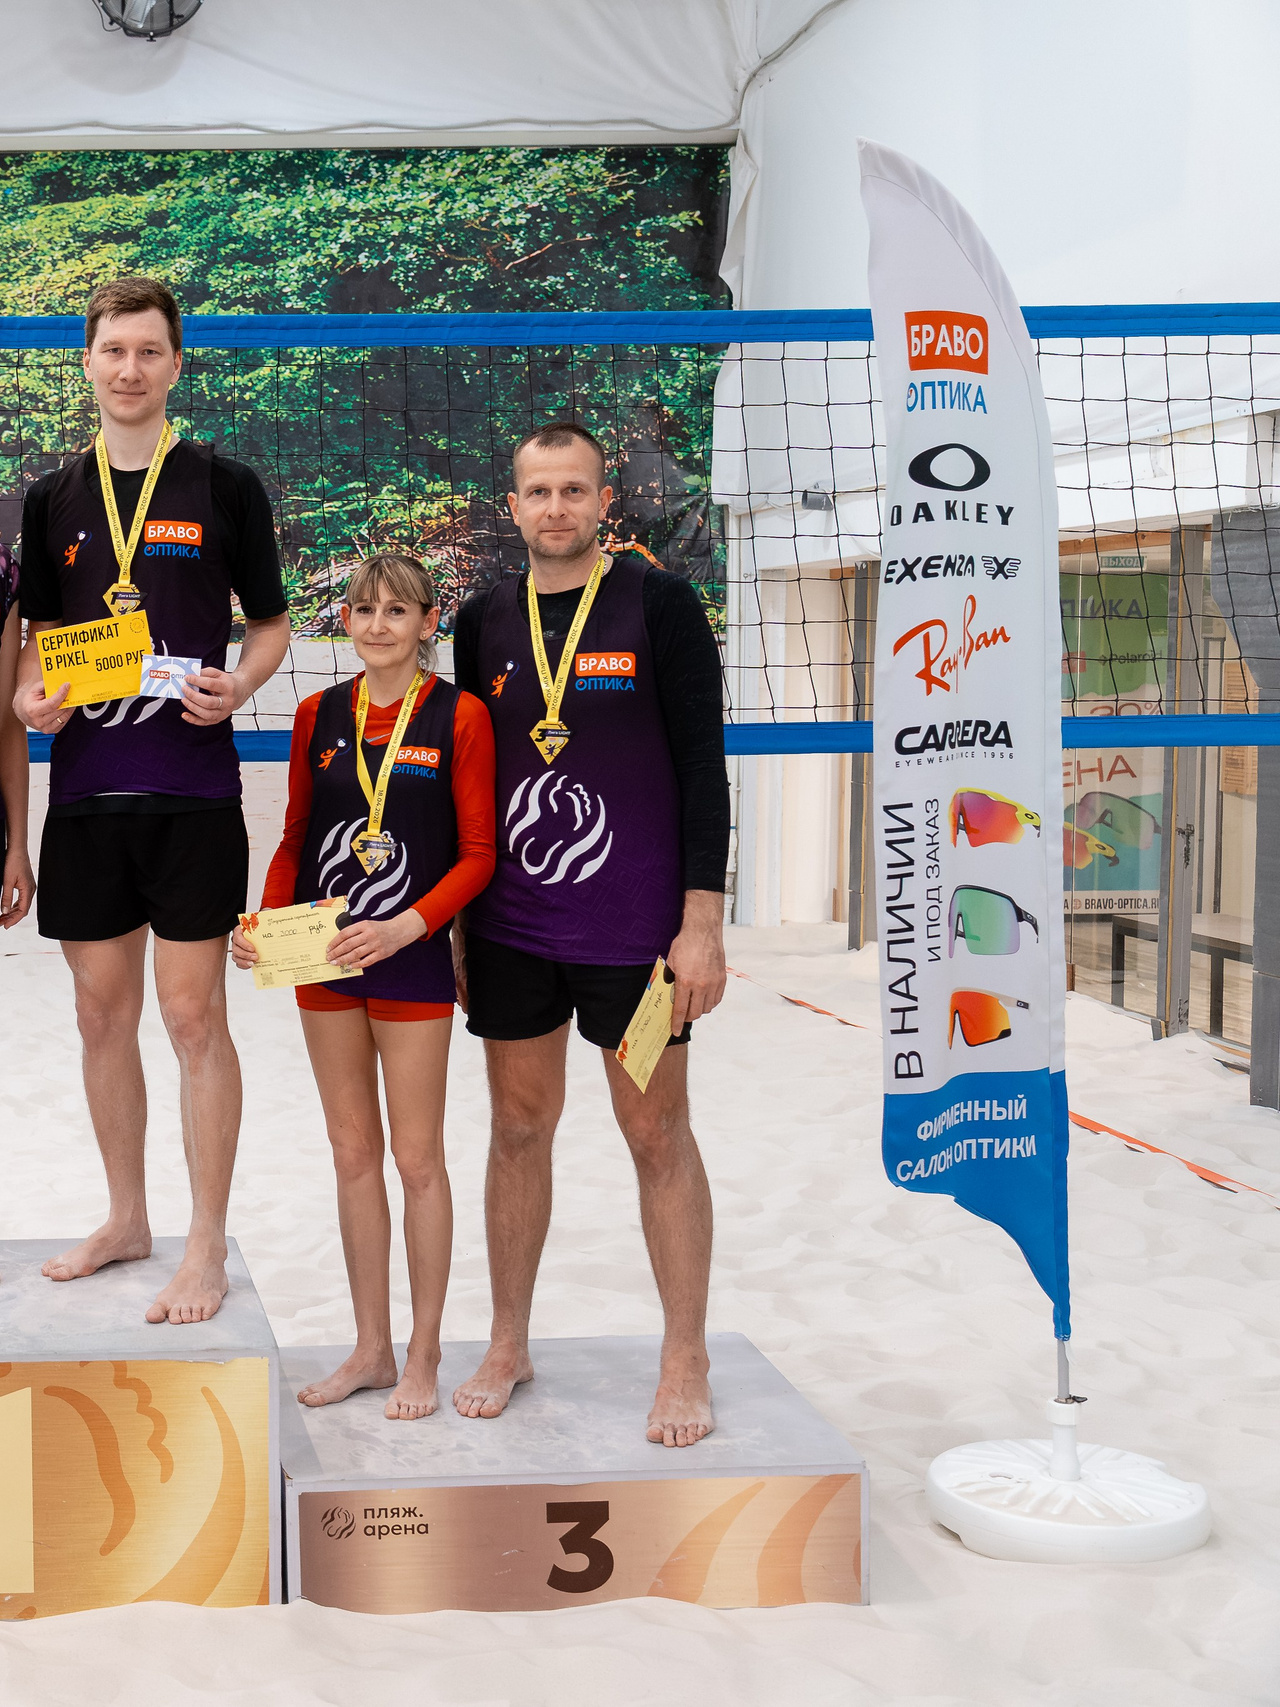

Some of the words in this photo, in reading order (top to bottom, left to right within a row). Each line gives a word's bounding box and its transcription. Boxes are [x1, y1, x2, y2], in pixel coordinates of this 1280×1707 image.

[909, 324, 983, 360] БРАВО
[906, 380, 988, 414] ОПТИКА
[144, 473, 154, 494] сезона
[890, 499, 1014, 526] OAKLEY
[148, 525, 198, 540] БРАВО
[143, 544, 200, 560] ОПТИКА
[1101, 556, 1140, 567] ВЫХОД
[884, 554, 975, 584] EXENZA
[41, 622, 120, 652] СЕРТИФИКАТ
[569, 629, 577, 643] 2025
[45, 656, 53, 672] В
[56, 649, 89, 670] PIXEL
[95, 654, 124, 672] 5000
[562, 650, 570, 665] 2026
[579, 657, 632, 671] БРАВО
[1112, 650, 1163, 665] Polaroid
[549, 676, 564, 710] 18.04.2026
[575, 677, 635, 691] ОПТИКА
[894, 719, 1014, 756] CARRERA
[397, 750, 438, 763] БРАВО
[984, 751, 1014, 759] 1956
[391, 764, 437, 780] ОПТИКА
[370, 789, 386, 823] 18.04.2026
[924, 798, 940, 881] ЗАКАЗ
[884, 801, 920, 1036] НАЛИЧИИ
[926, 886, 944, 942] ПОД
[926, 945, 941, 962] И
[894, 1050, 924, 1080] В
[916, 1093, 1027, 1143] ФИРМЕННЫЙ
[895, 1149, 953, 1183] САЛОН
[954, 1134, 1037, 1163] ОПТИКИ
[363, 1506, 424, 1519] пляж.
[363, 1523, 429, 1540] арена
[546, 1500, 615, 1594] 3
